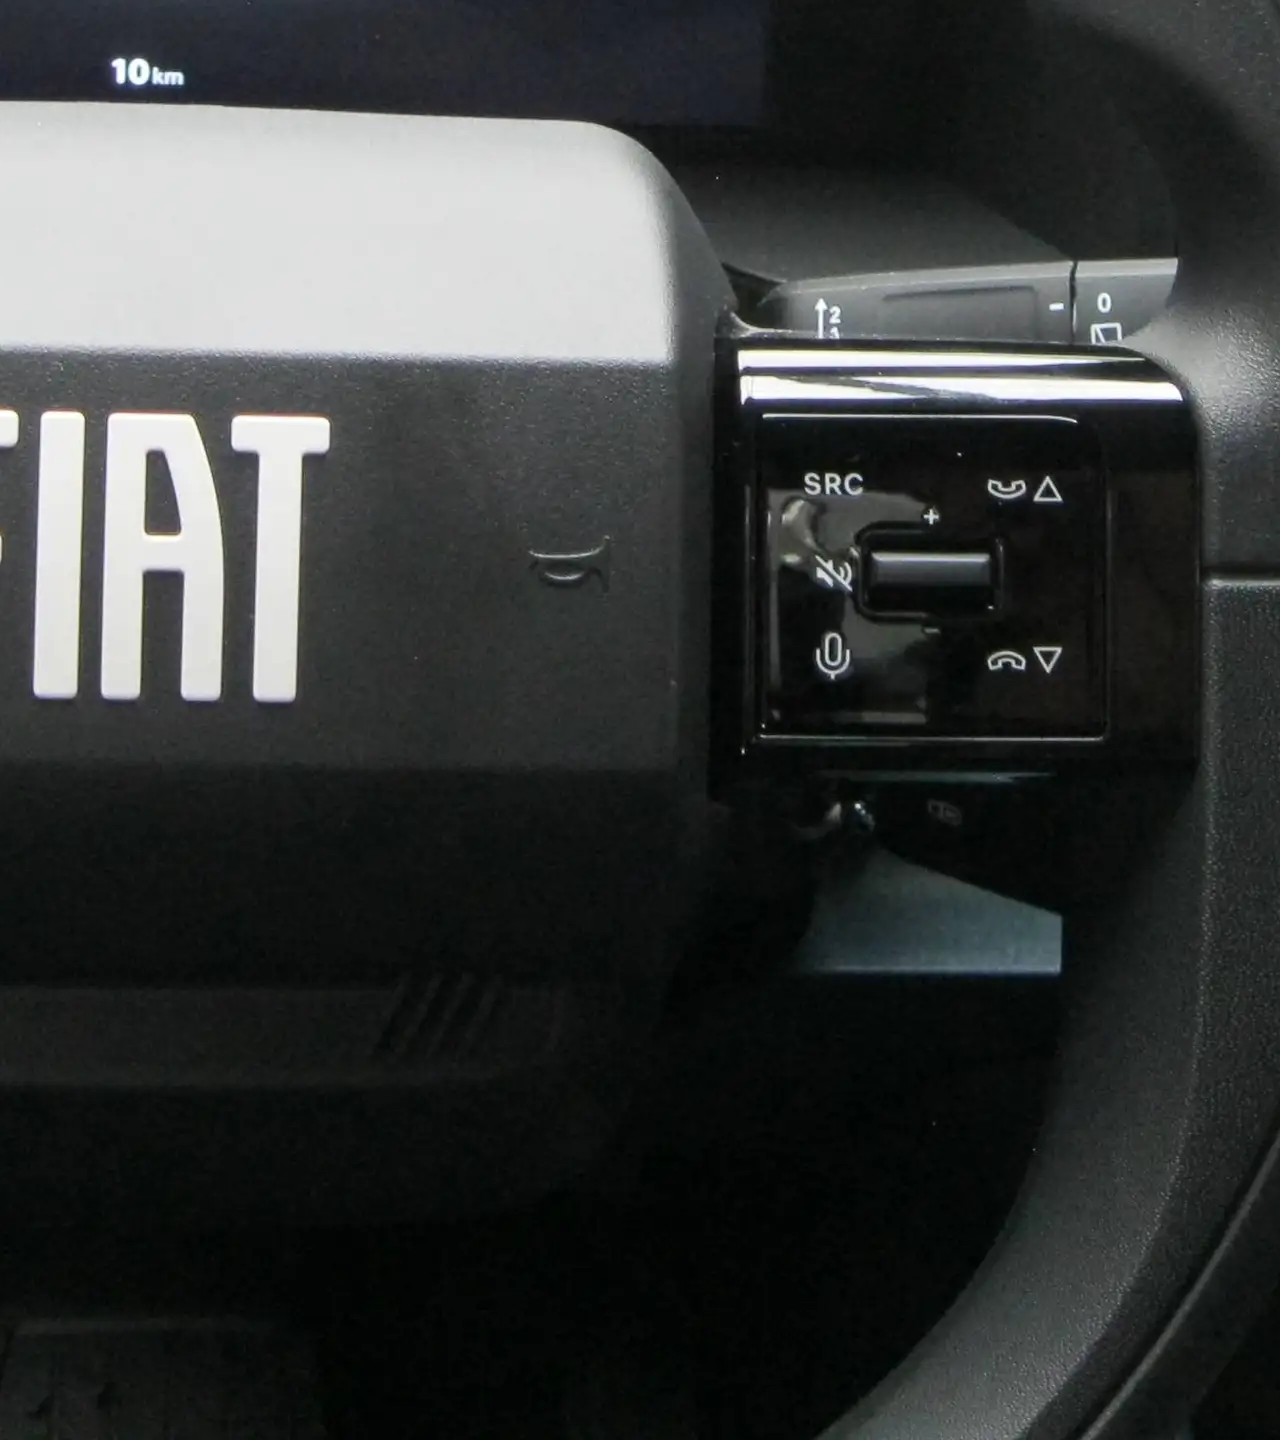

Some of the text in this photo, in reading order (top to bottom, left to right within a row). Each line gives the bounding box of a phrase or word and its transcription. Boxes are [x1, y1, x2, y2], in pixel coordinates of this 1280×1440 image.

[1097, 292, 1112, 313] 0
[829, 305, 841, 324] 2
[804, 472, 864, 496] SRC
